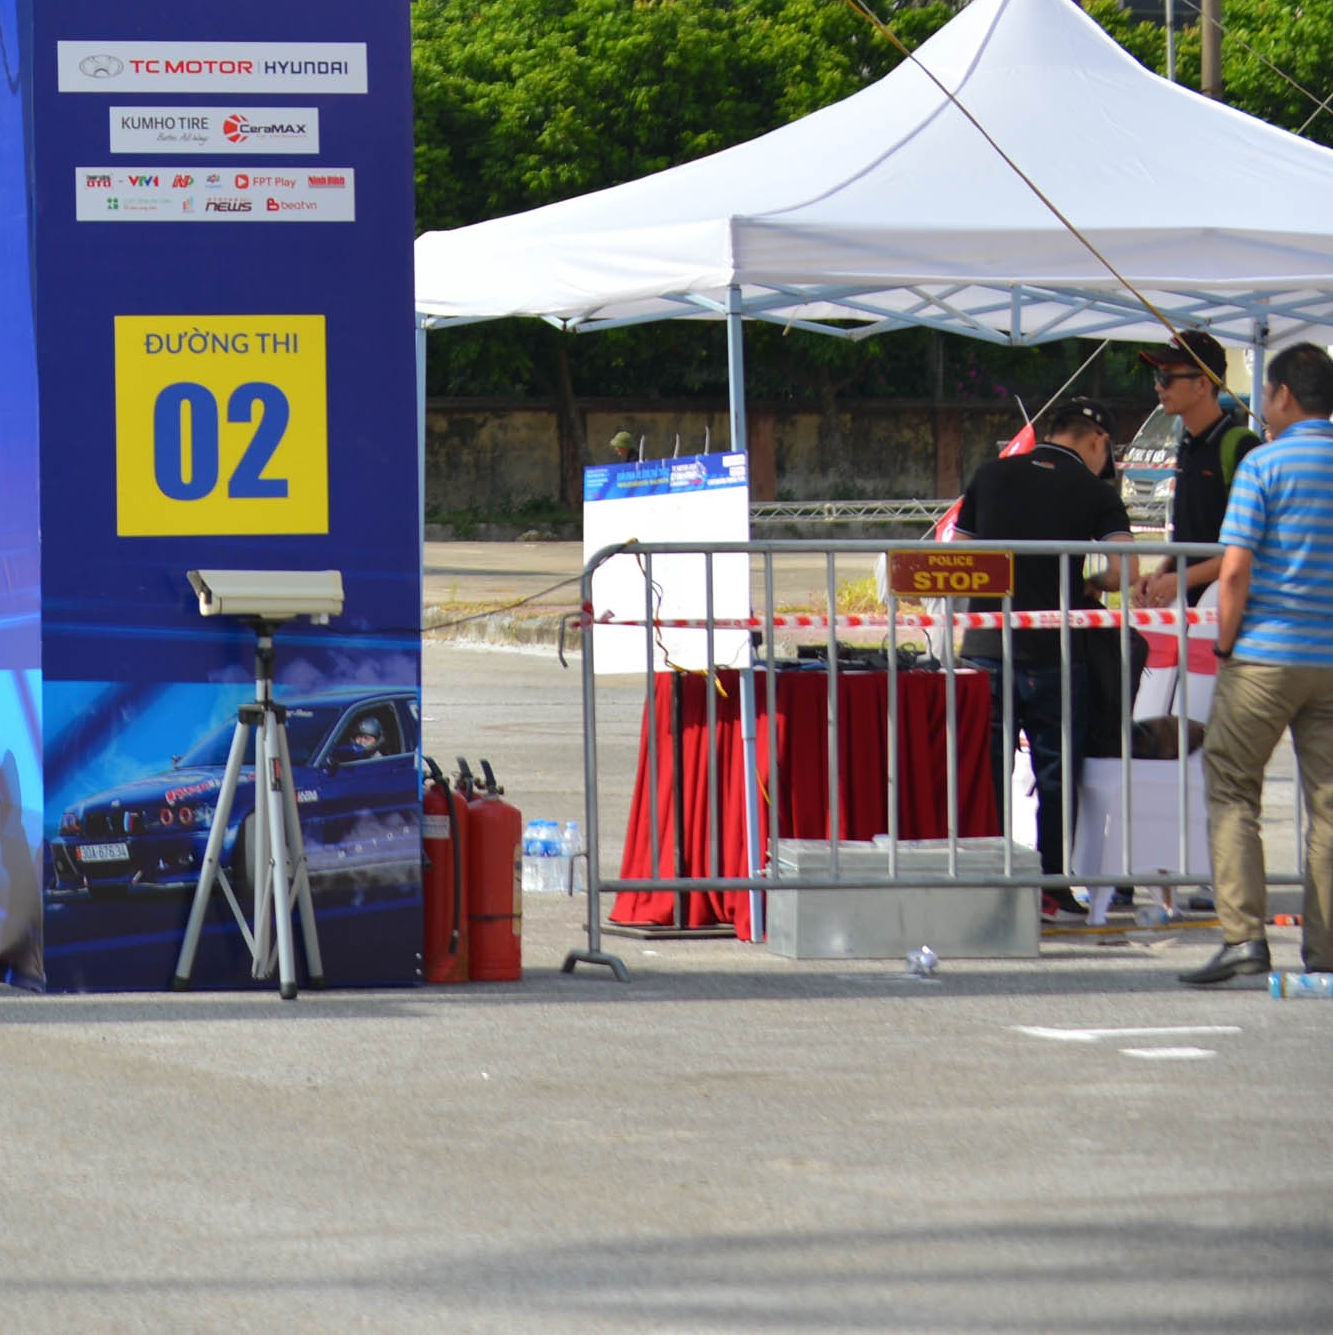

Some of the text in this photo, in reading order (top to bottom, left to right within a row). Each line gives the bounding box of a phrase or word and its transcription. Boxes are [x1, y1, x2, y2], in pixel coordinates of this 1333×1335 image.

[129, 59, 348, 75] TC MOTOR HYUNDAI
[121, 116, 209, 130] KUMHO TIRE
[239, 124, 307, 133] CeraMAX
[144, 327, 299, 355] ĐƯỜNG THI
[153, 381, 291, 502] 02
[928, 555, 974, 567] POLICE
[913, 571, 991, 590] STOP
